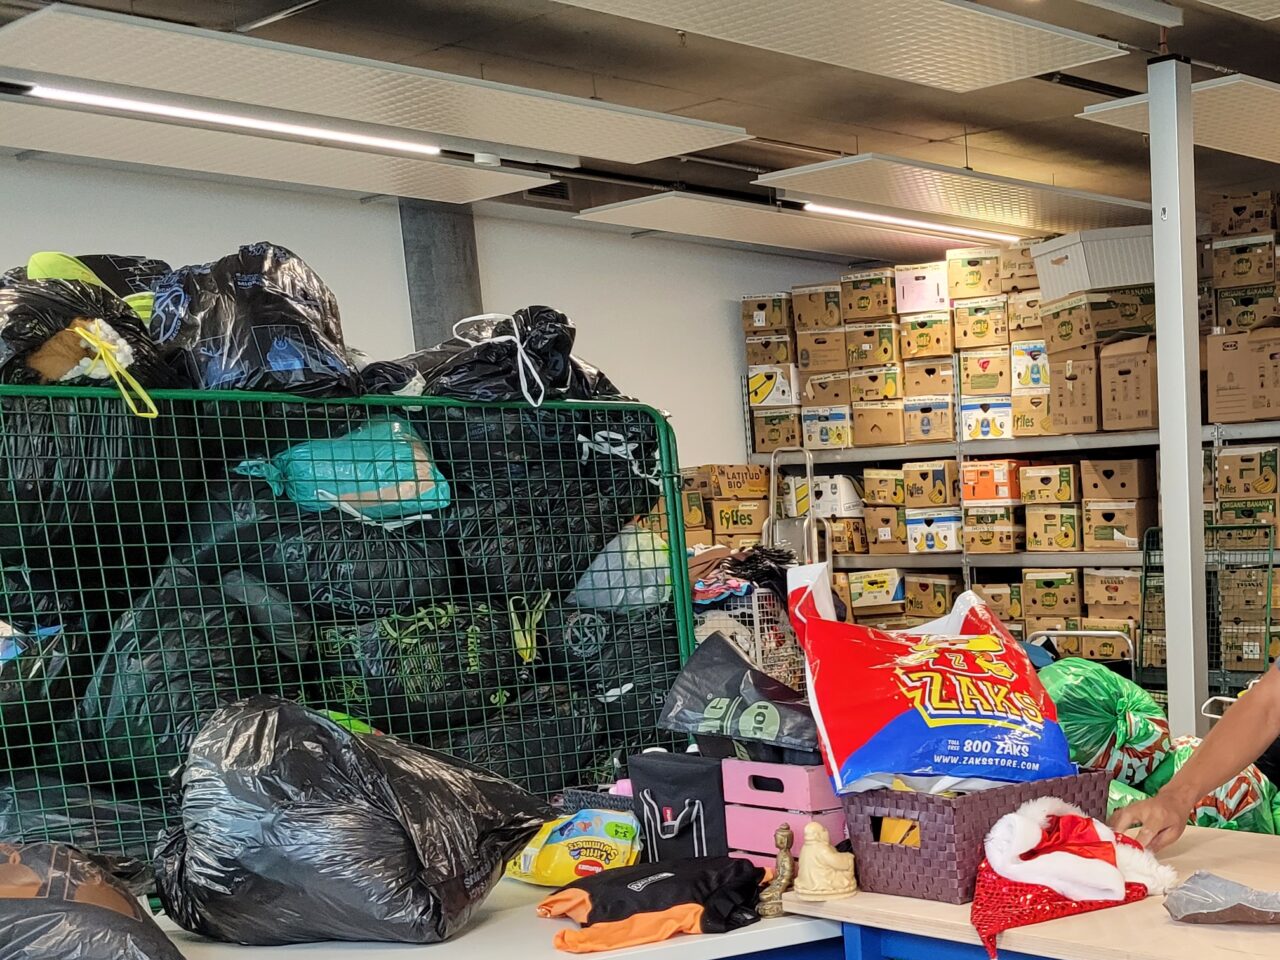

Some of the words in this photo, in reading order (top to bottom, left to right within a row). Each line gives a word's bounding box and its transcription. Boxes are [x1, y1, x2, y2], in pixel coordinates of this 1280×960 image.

[945, 652, 968, 670] Z
[908, 670, 1045, 729] ZAKS
[963, 738, 992, 754] 800
[996, 740, 1030, 758] ZAKS
[933, 753, 1040, 772] WWW.ZAKSSTORE.COM
[614, 829, 629, 838] 3-4
[567, 840, 618, 860] Swimmers
[580, 848, 608, 861] Little
